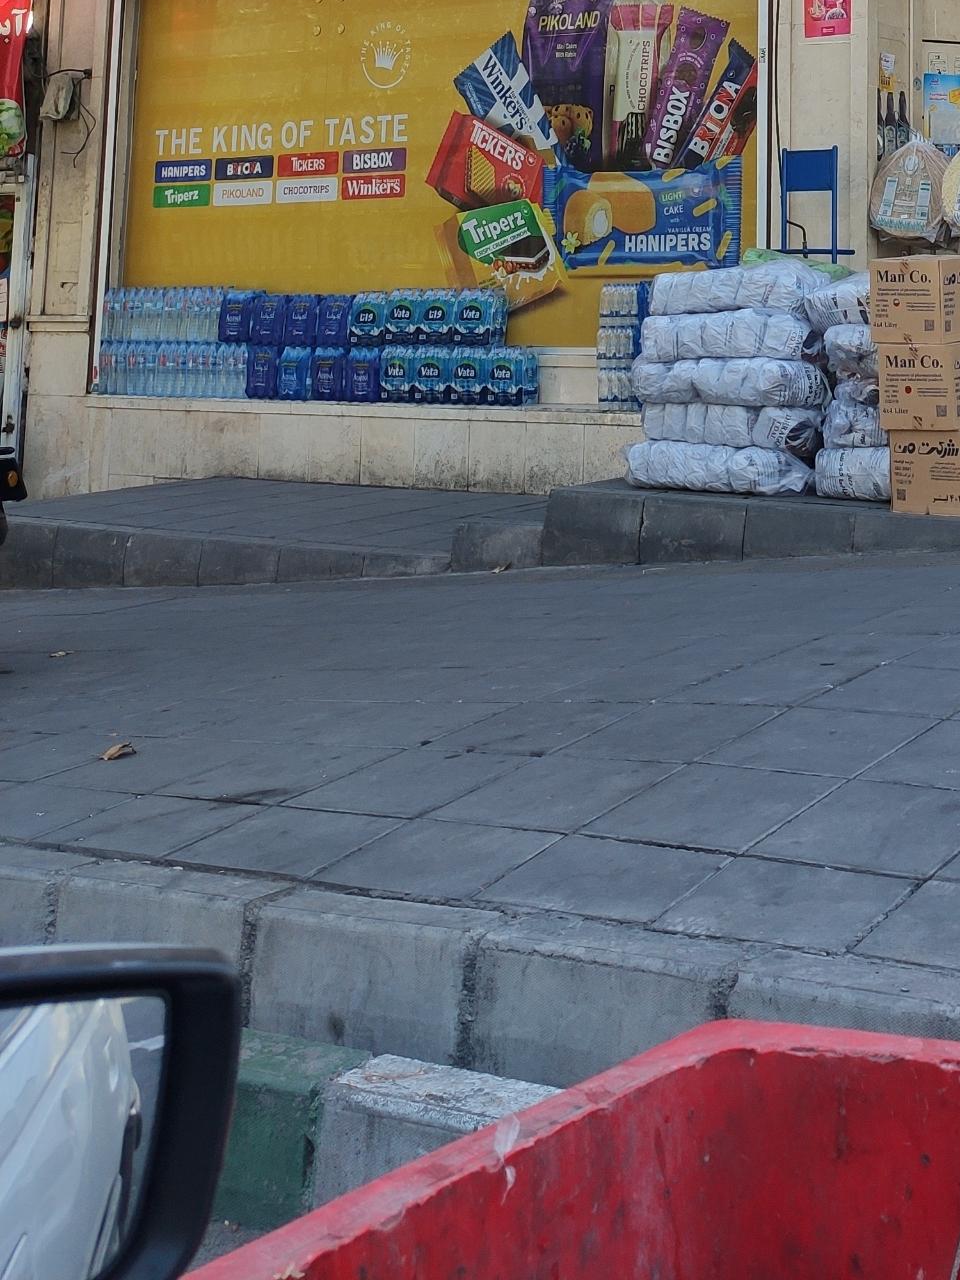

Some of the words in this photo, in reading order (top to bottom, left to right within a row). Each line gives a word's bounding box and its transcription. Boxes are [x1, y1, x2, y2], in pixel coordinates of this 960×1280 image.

[538, 11, 600, 32] PIKOLAND
[638, 40, 650, 111] CHOCOTRIPS
[482, 54, 527, 130] Winkers
[652, 86, 690, 164] BISBOX
[688, 80, 742, 158] BRITONA
[155, 127, 203, 155] THE
[212, 123, 273, 153] KING
[281, 120, 314, 149] OF
[325, 114, 409, 146] TASTE
[469, 119, 525, 171] TICKERS
[291, 156, 325, 172] TICKERS
[353, 152, 393, 170] BISBOX
[161, 166, 206, 178] HANIPERS
[222, 188, 264, 198] PIKOLAND
[283, 185, 330, 195] CHOCOTRIPS
[347, 179, 401, 197] Winkers
[165, 188, 199, 204] Triperz
[661, 192, 683, 201] LIGHT
[663, 205, 684, 216] CAKE
[462, 210, 526, 244] Triperz
[624, 233, 711, 253] HANIPERS
[877, 270, 905, 283] Man
[910, 270, 931, 283] Co.
[943, 273, 956, 285] من
[393, 306, 410, 318] Vata
[463, 308, 480, 319] Vata
[885, 355, 915, 368] Man
[921, 355, 943, 368] Co.
[388, 366, 404, 376] Vata
[420, 365, 438, 376] Vata
[458, 367, 475, 378] Vata
[494, 368, 511, 379] Vata
[894, 442, 916, 454] من
[918, 439, 960, 458] شرکت
